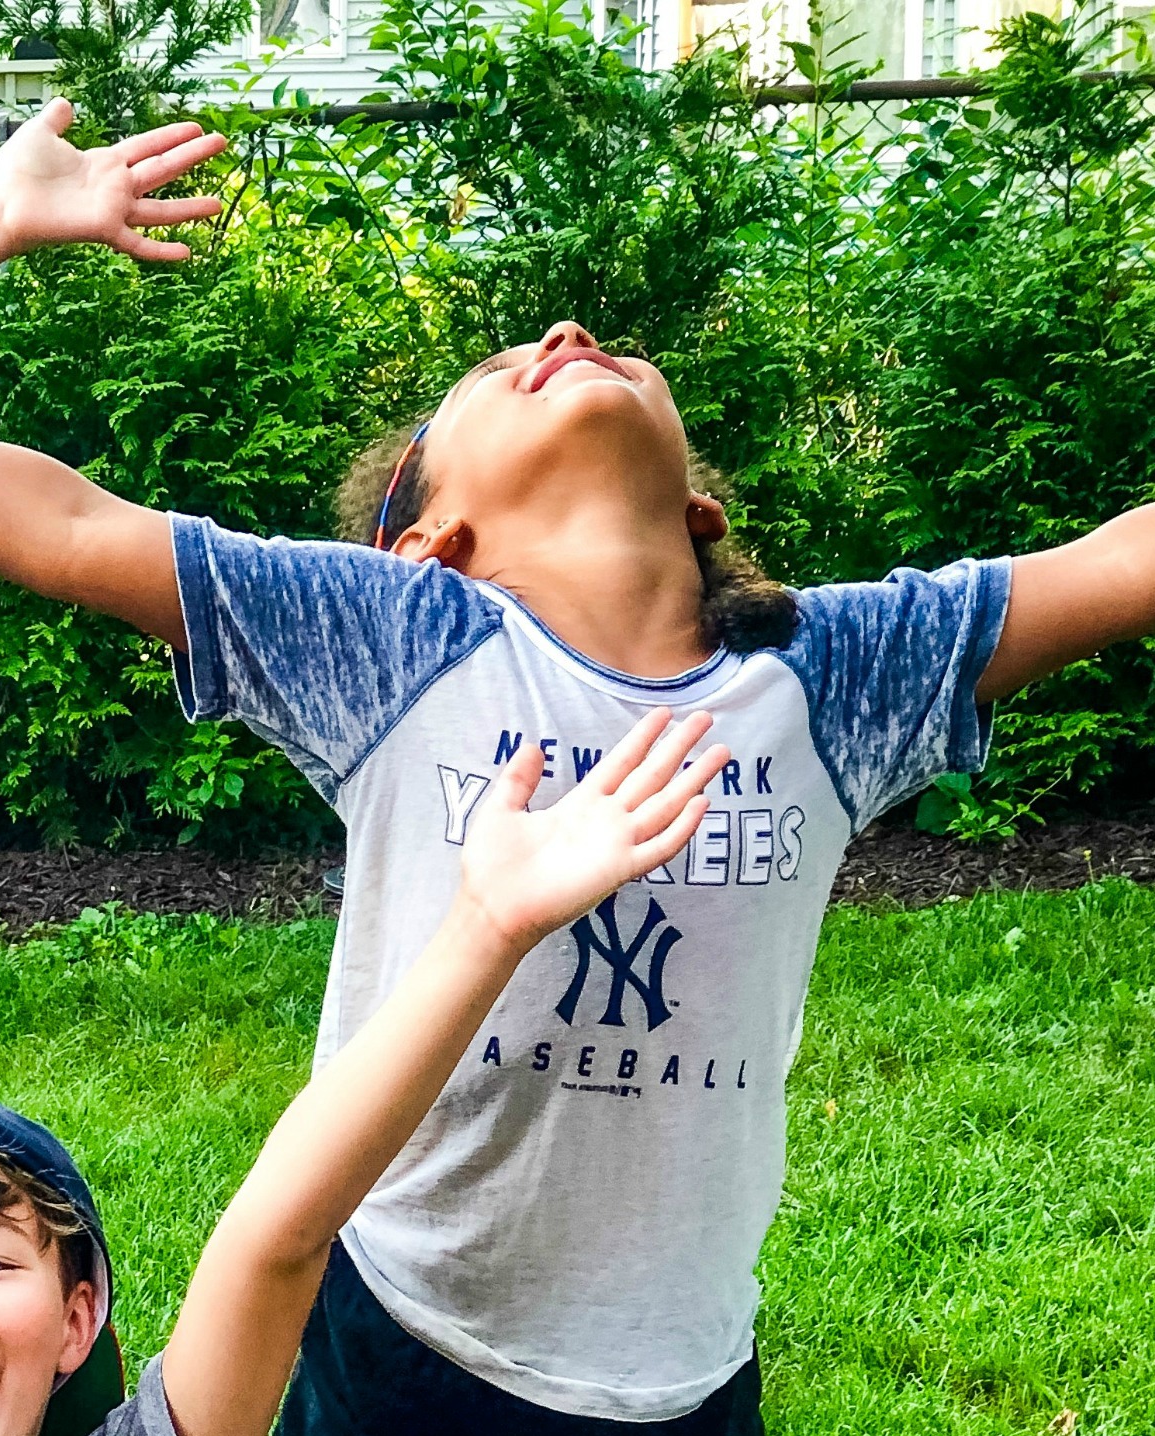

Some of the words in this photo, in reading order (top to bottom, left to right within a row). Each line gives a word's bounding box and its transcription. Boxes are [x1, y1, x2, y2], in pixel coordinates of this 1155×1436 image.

[436, 763, 806, 887] YEES
[554, 891, 683, 1033] NY
[482, 1035, 747, 1089] ASEBALL
